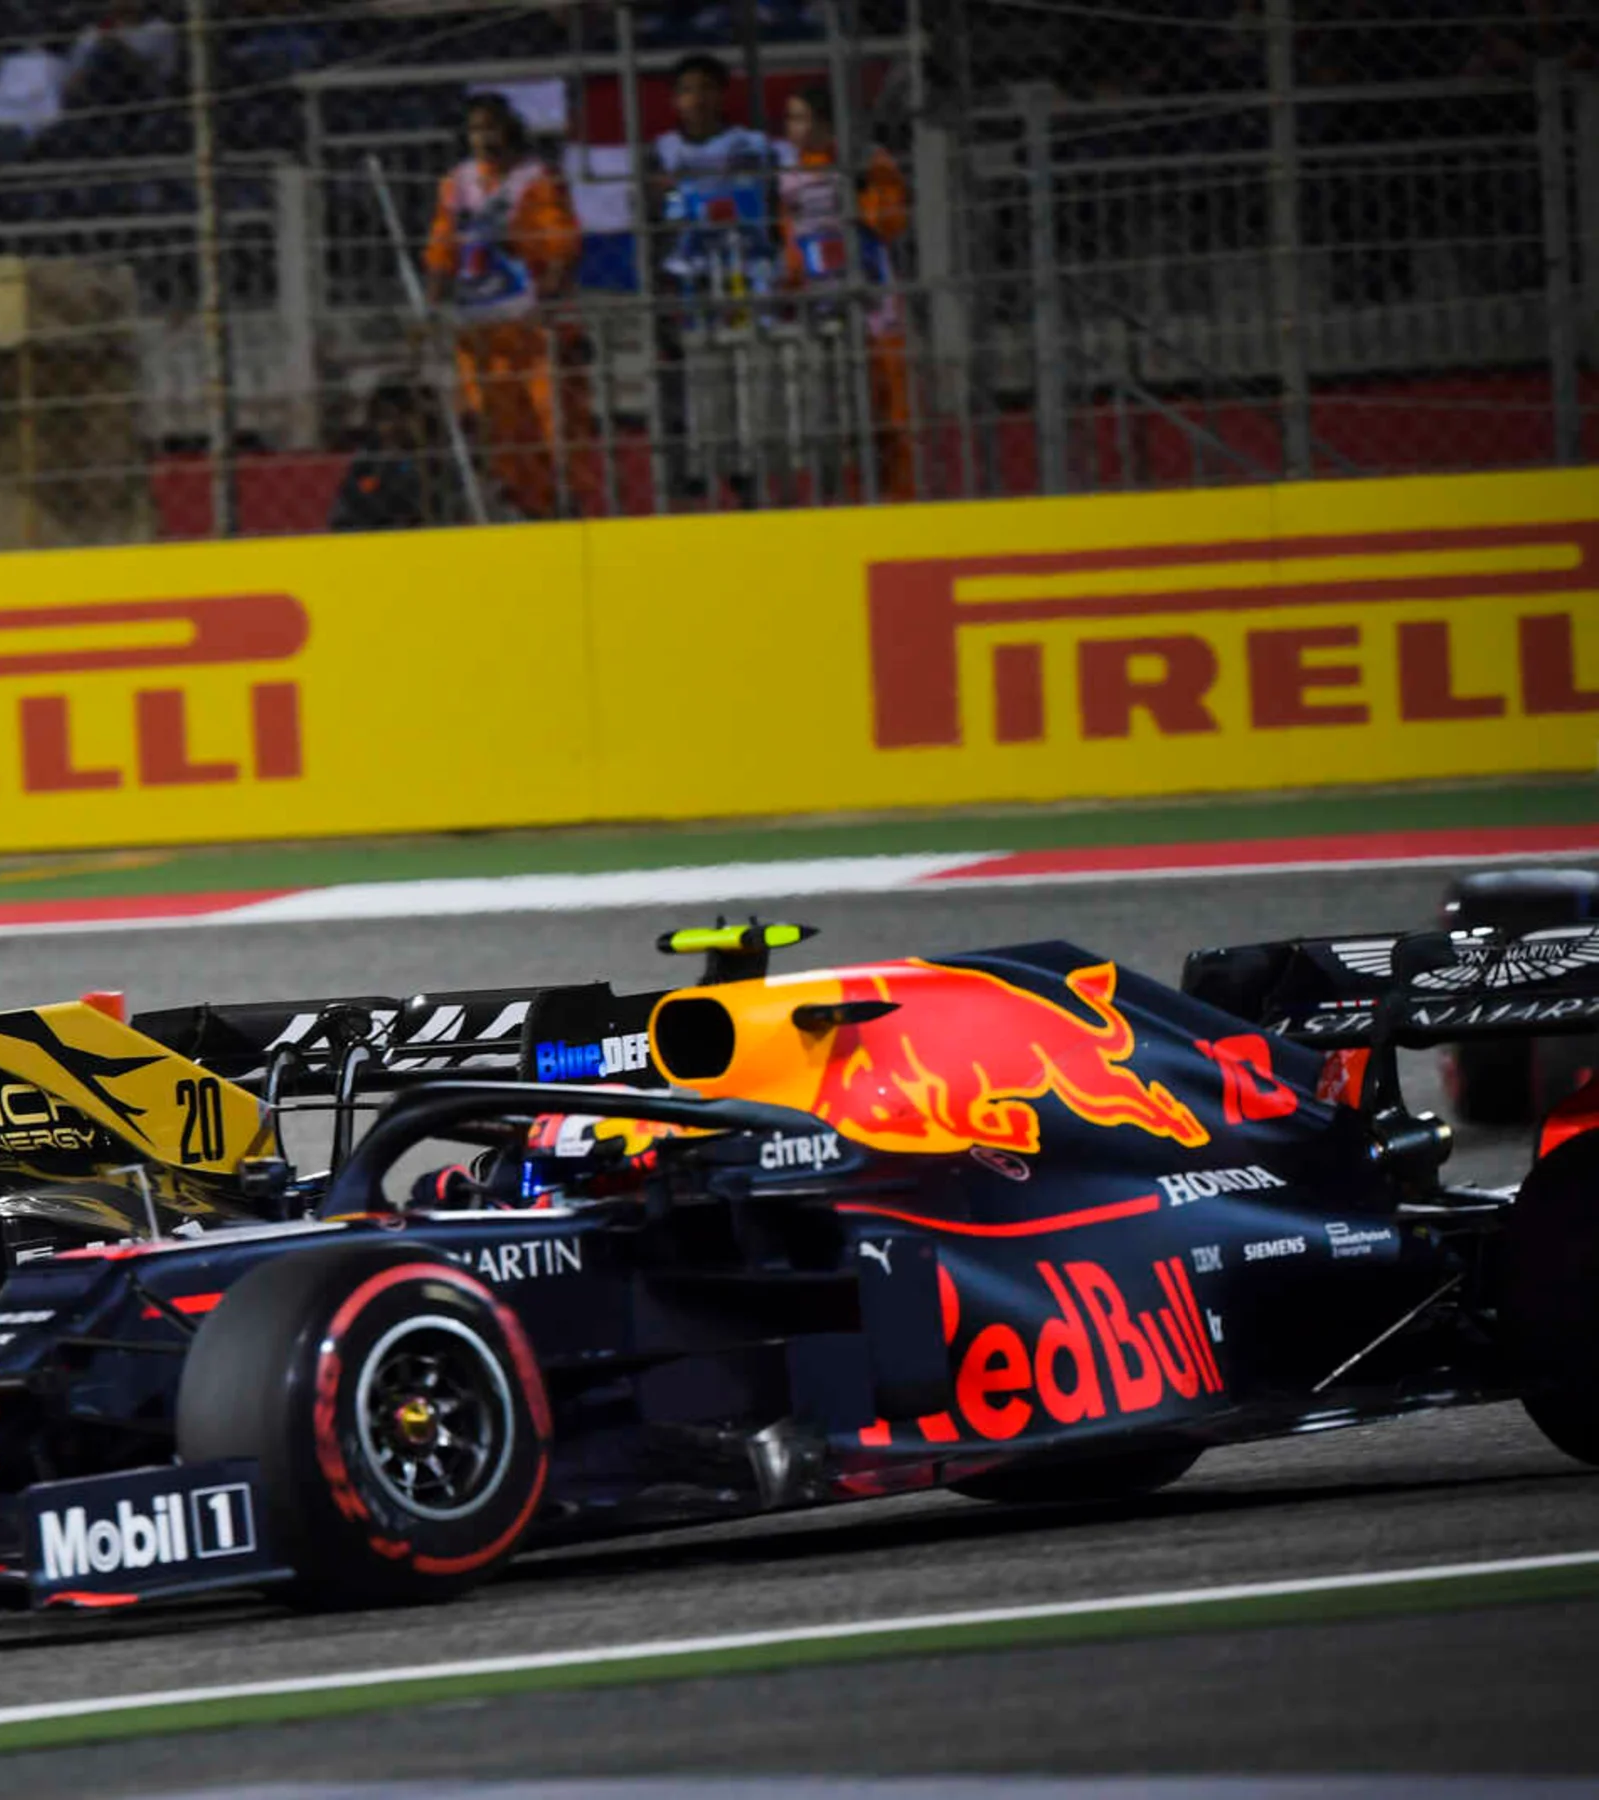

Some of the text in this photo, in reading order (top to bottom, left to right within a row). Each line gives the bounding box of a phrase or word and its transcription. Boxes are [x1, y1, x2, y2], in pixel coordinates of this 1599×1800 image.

[866, 519, 1599, 750] PIRELL
[1268, 1011, 1456, 1037] ASTN
[175, 1076, 225, 1165] 20
[1157, 1165, 1287, 1207] HONDA
[447, 1238, 583, 1282] ARTIN
[1243, 1236, 1307, 1262] SIEMENS
[39, 1492, 235, 1581] Mobil 1
